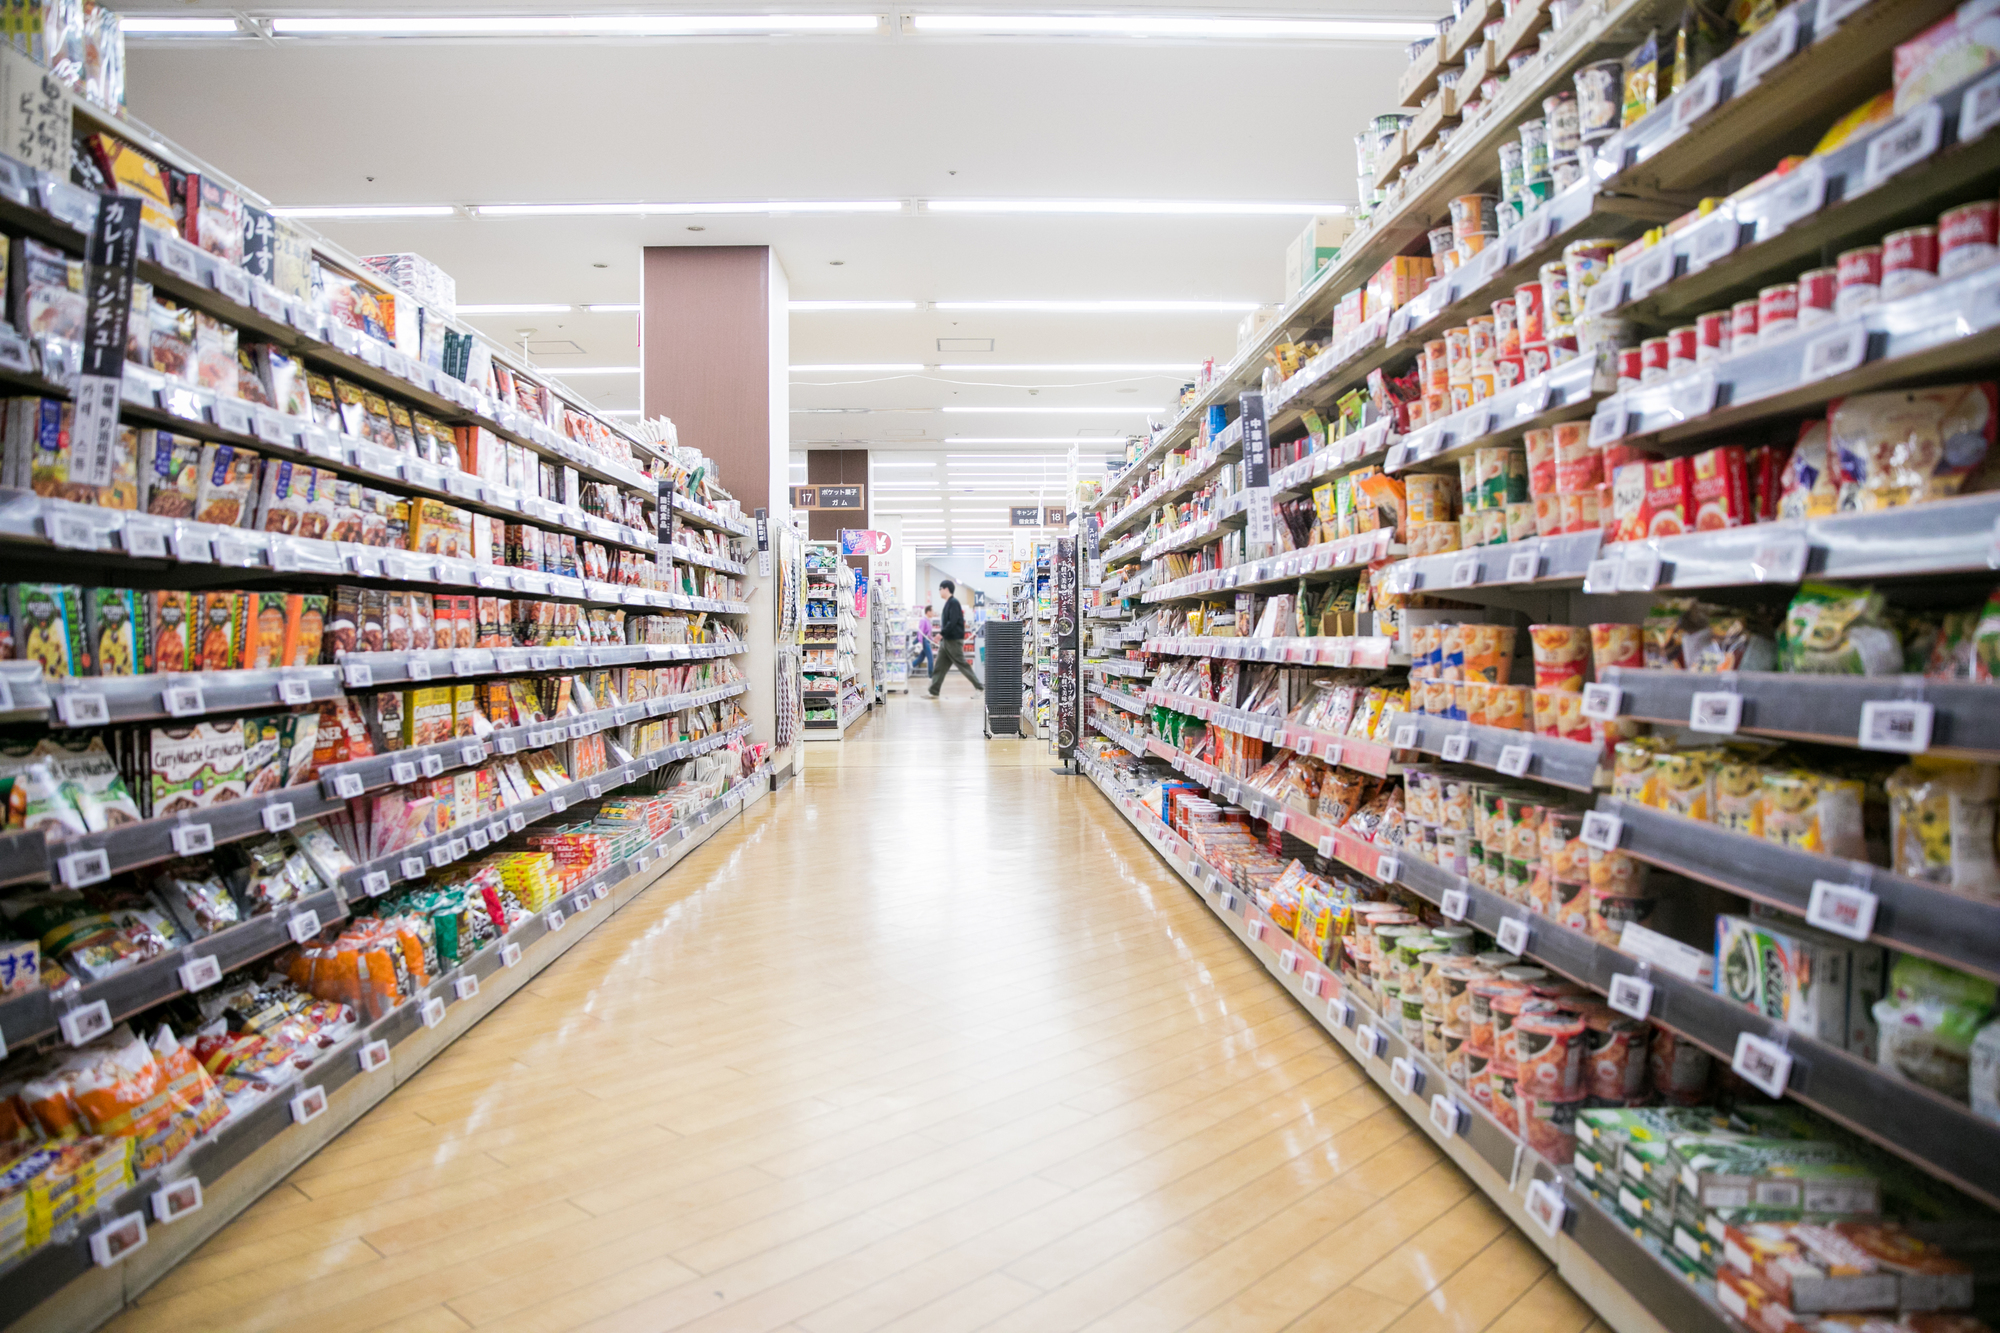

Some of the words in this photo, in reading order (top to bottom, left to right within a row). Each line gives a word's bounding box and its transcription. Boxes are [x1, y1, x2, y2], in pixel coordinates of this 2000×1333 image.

[93, 201, 125, 369] カレー・シチュー
[821, 488, 857, 496] ポケット菓子
[802, 493, 812, 502] 17
[1051, 513, 1061, 521] 18
[1020, 548, 1026, 556] 9
[975, 594, 985, 604] 14
